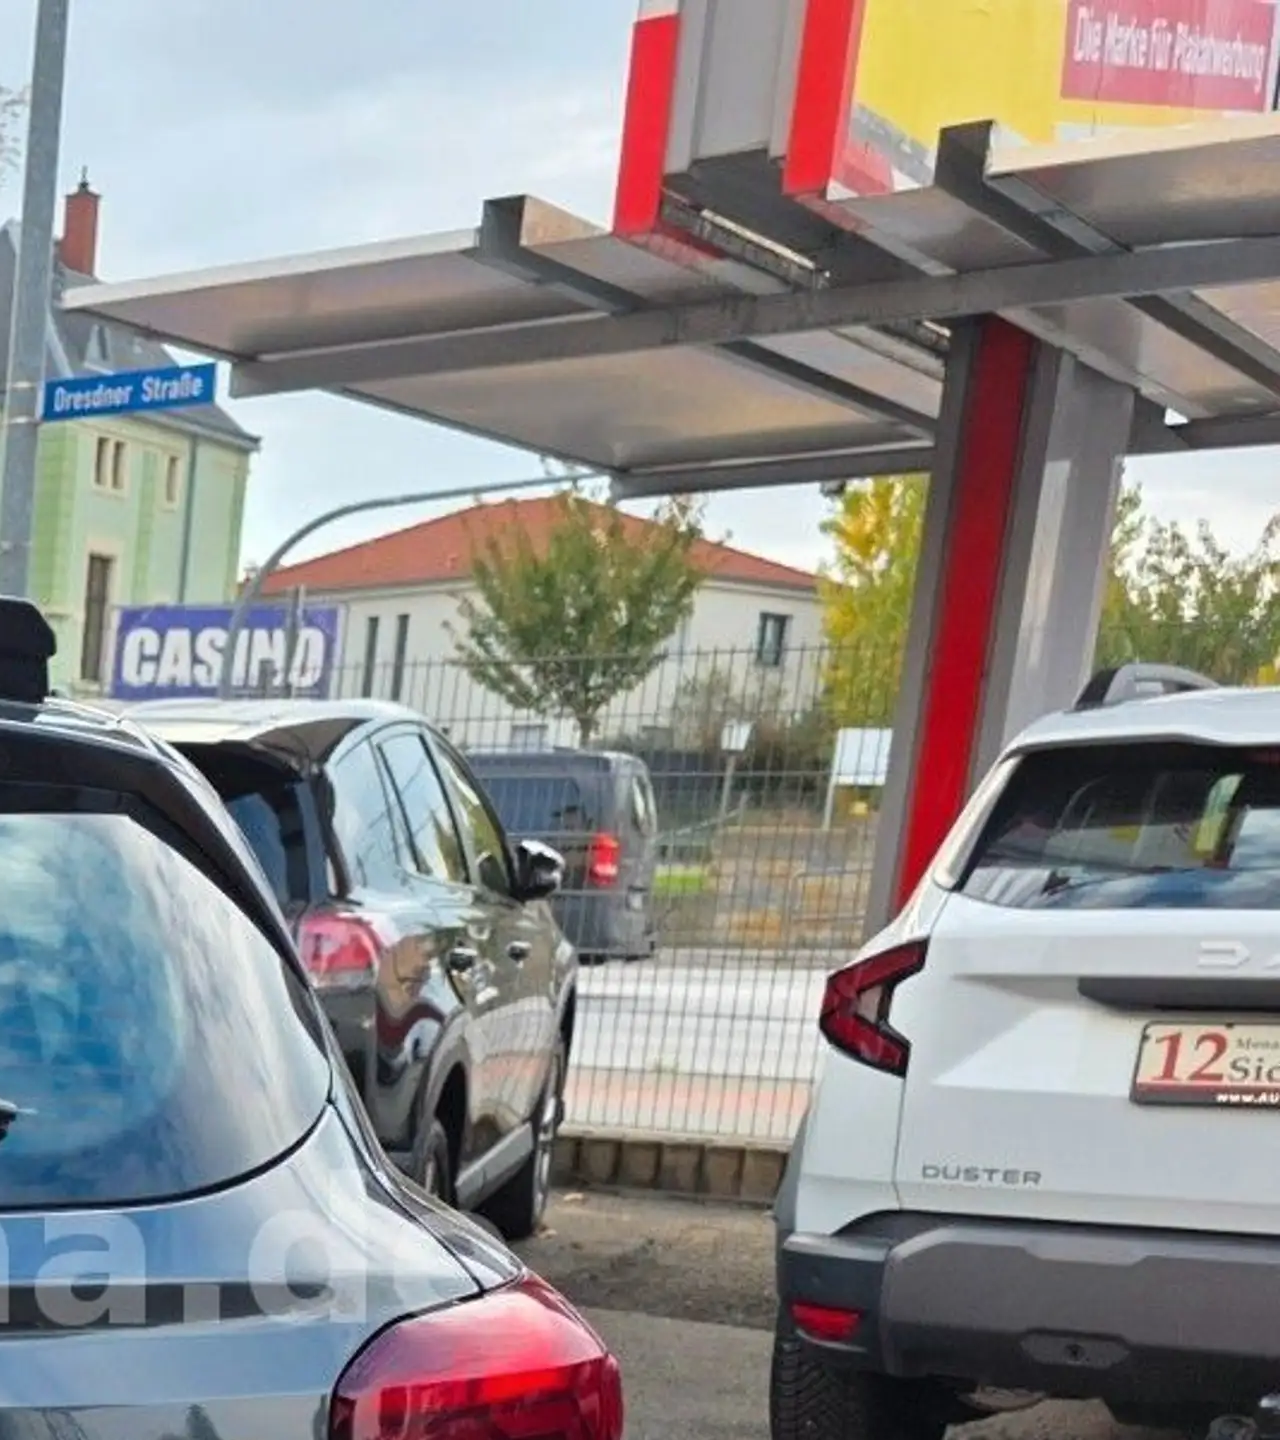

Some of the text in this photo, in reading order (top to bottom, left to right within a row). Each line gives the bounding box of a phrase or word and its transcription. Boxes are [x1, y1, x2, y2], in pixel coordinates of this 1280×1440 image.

[1073, 5, 1102, 62] Die
[1103, 12, 1148, 69] Marke
[1148, 17, 1173, 71] für
[53, 371, 204, 413] Dresdner Straße
[122, 626, 326, 689] CASINO
[1151, 1029, 1228, 1082] 12
[922, 1164, 1042, 1185] DUSTER
